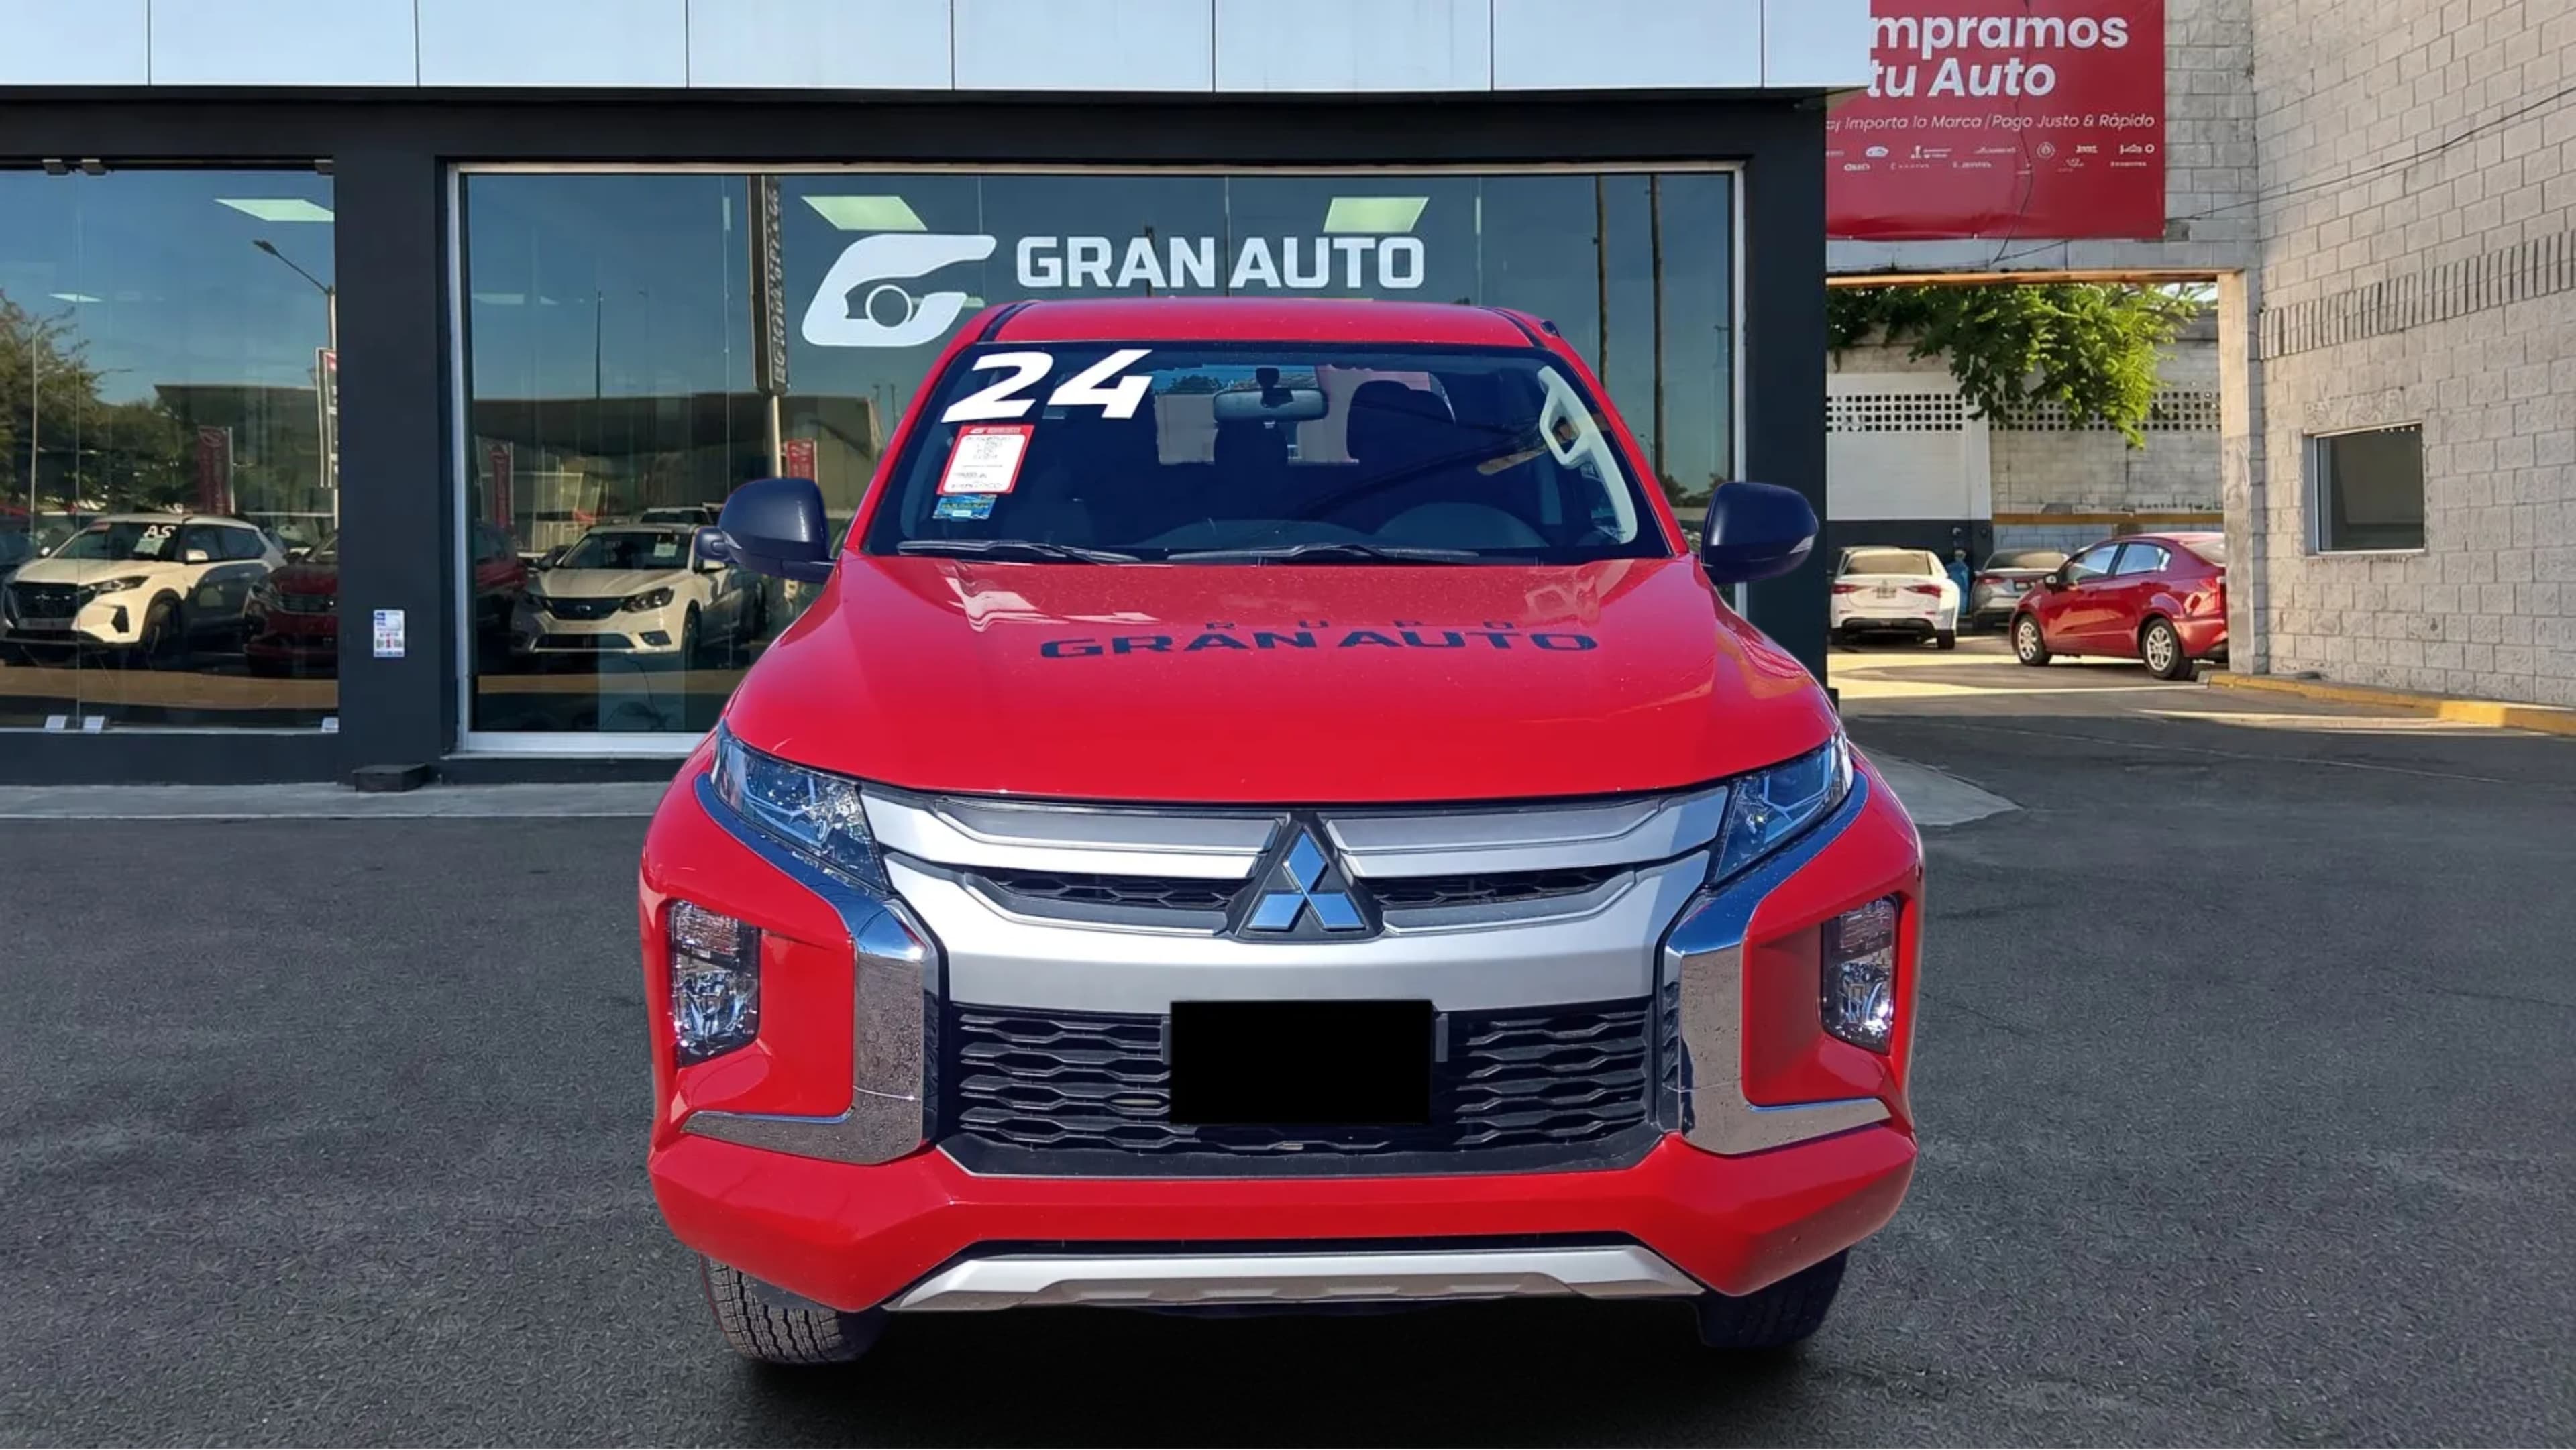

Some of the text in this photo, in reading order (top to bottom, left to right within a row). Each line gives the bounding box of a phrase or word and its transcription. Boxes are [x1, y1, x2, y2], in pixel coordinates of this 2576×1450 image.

[1867, 56, 2055, 97] tu Auto
[1931, 115, 1982, 128] Marca
[2037, 115, 2080, 128] Justo
[2082, 114, 2094, 127] &
[1016, 236, 1424, 289] GRAN AUTO
[941, 349, 1153, 423] 24
[1040, 630, 1598, 659] GRAN AUTO
